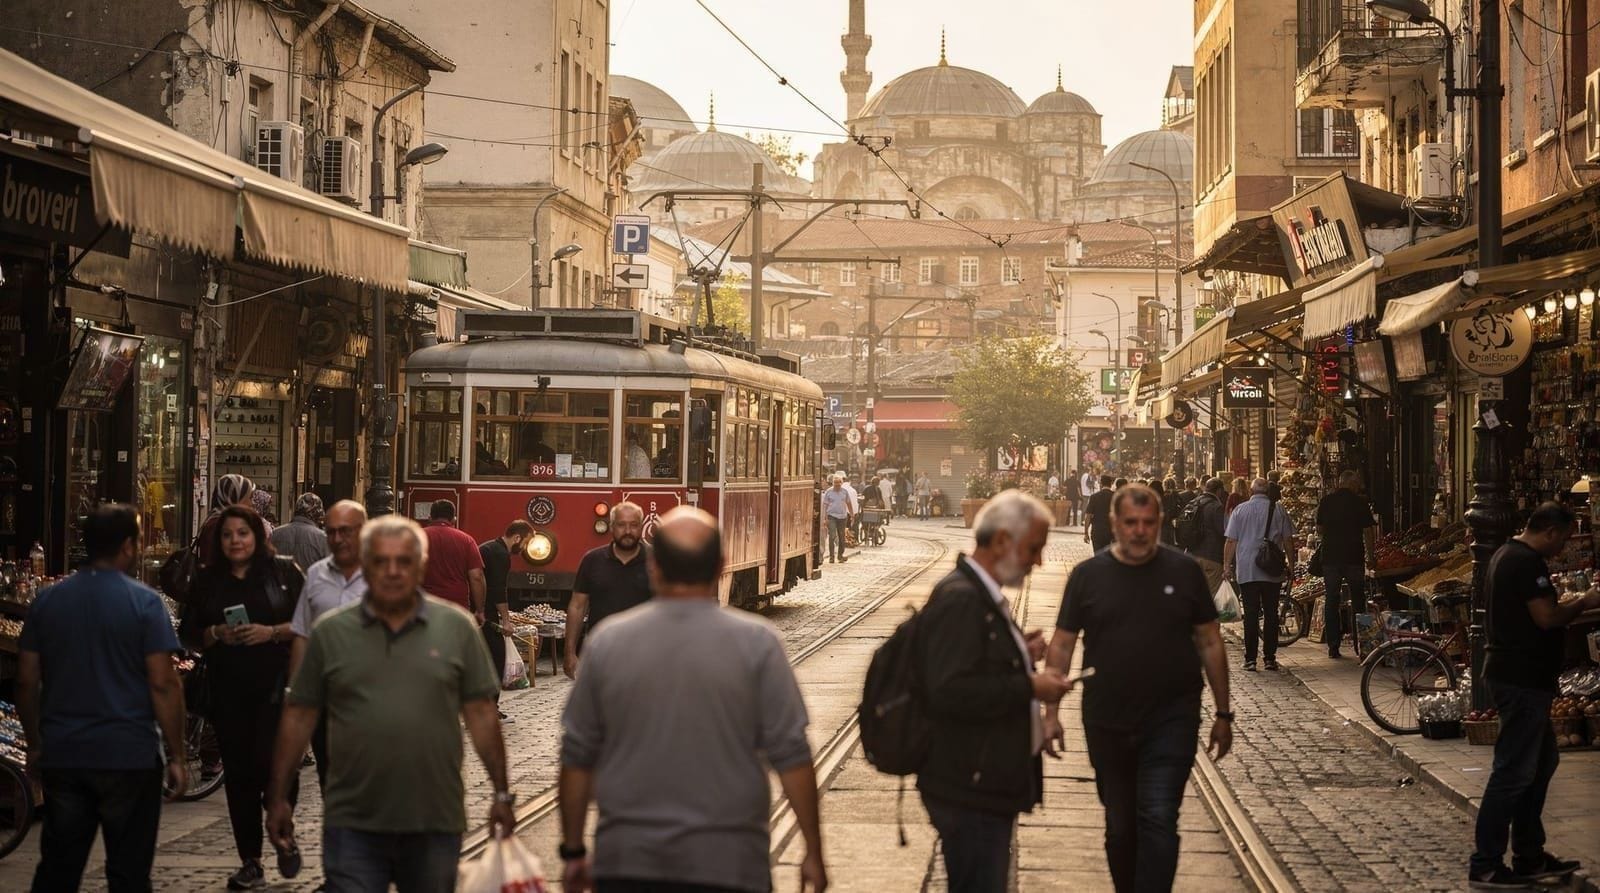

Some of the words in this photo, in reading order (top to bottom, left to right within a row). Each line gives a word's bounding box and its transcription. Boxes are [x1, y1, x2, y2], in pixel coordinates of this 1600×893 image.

[2, 163, 80, 234] broveri
[623, 225, 641, 252] P
[830, 398, 839, 411] P
